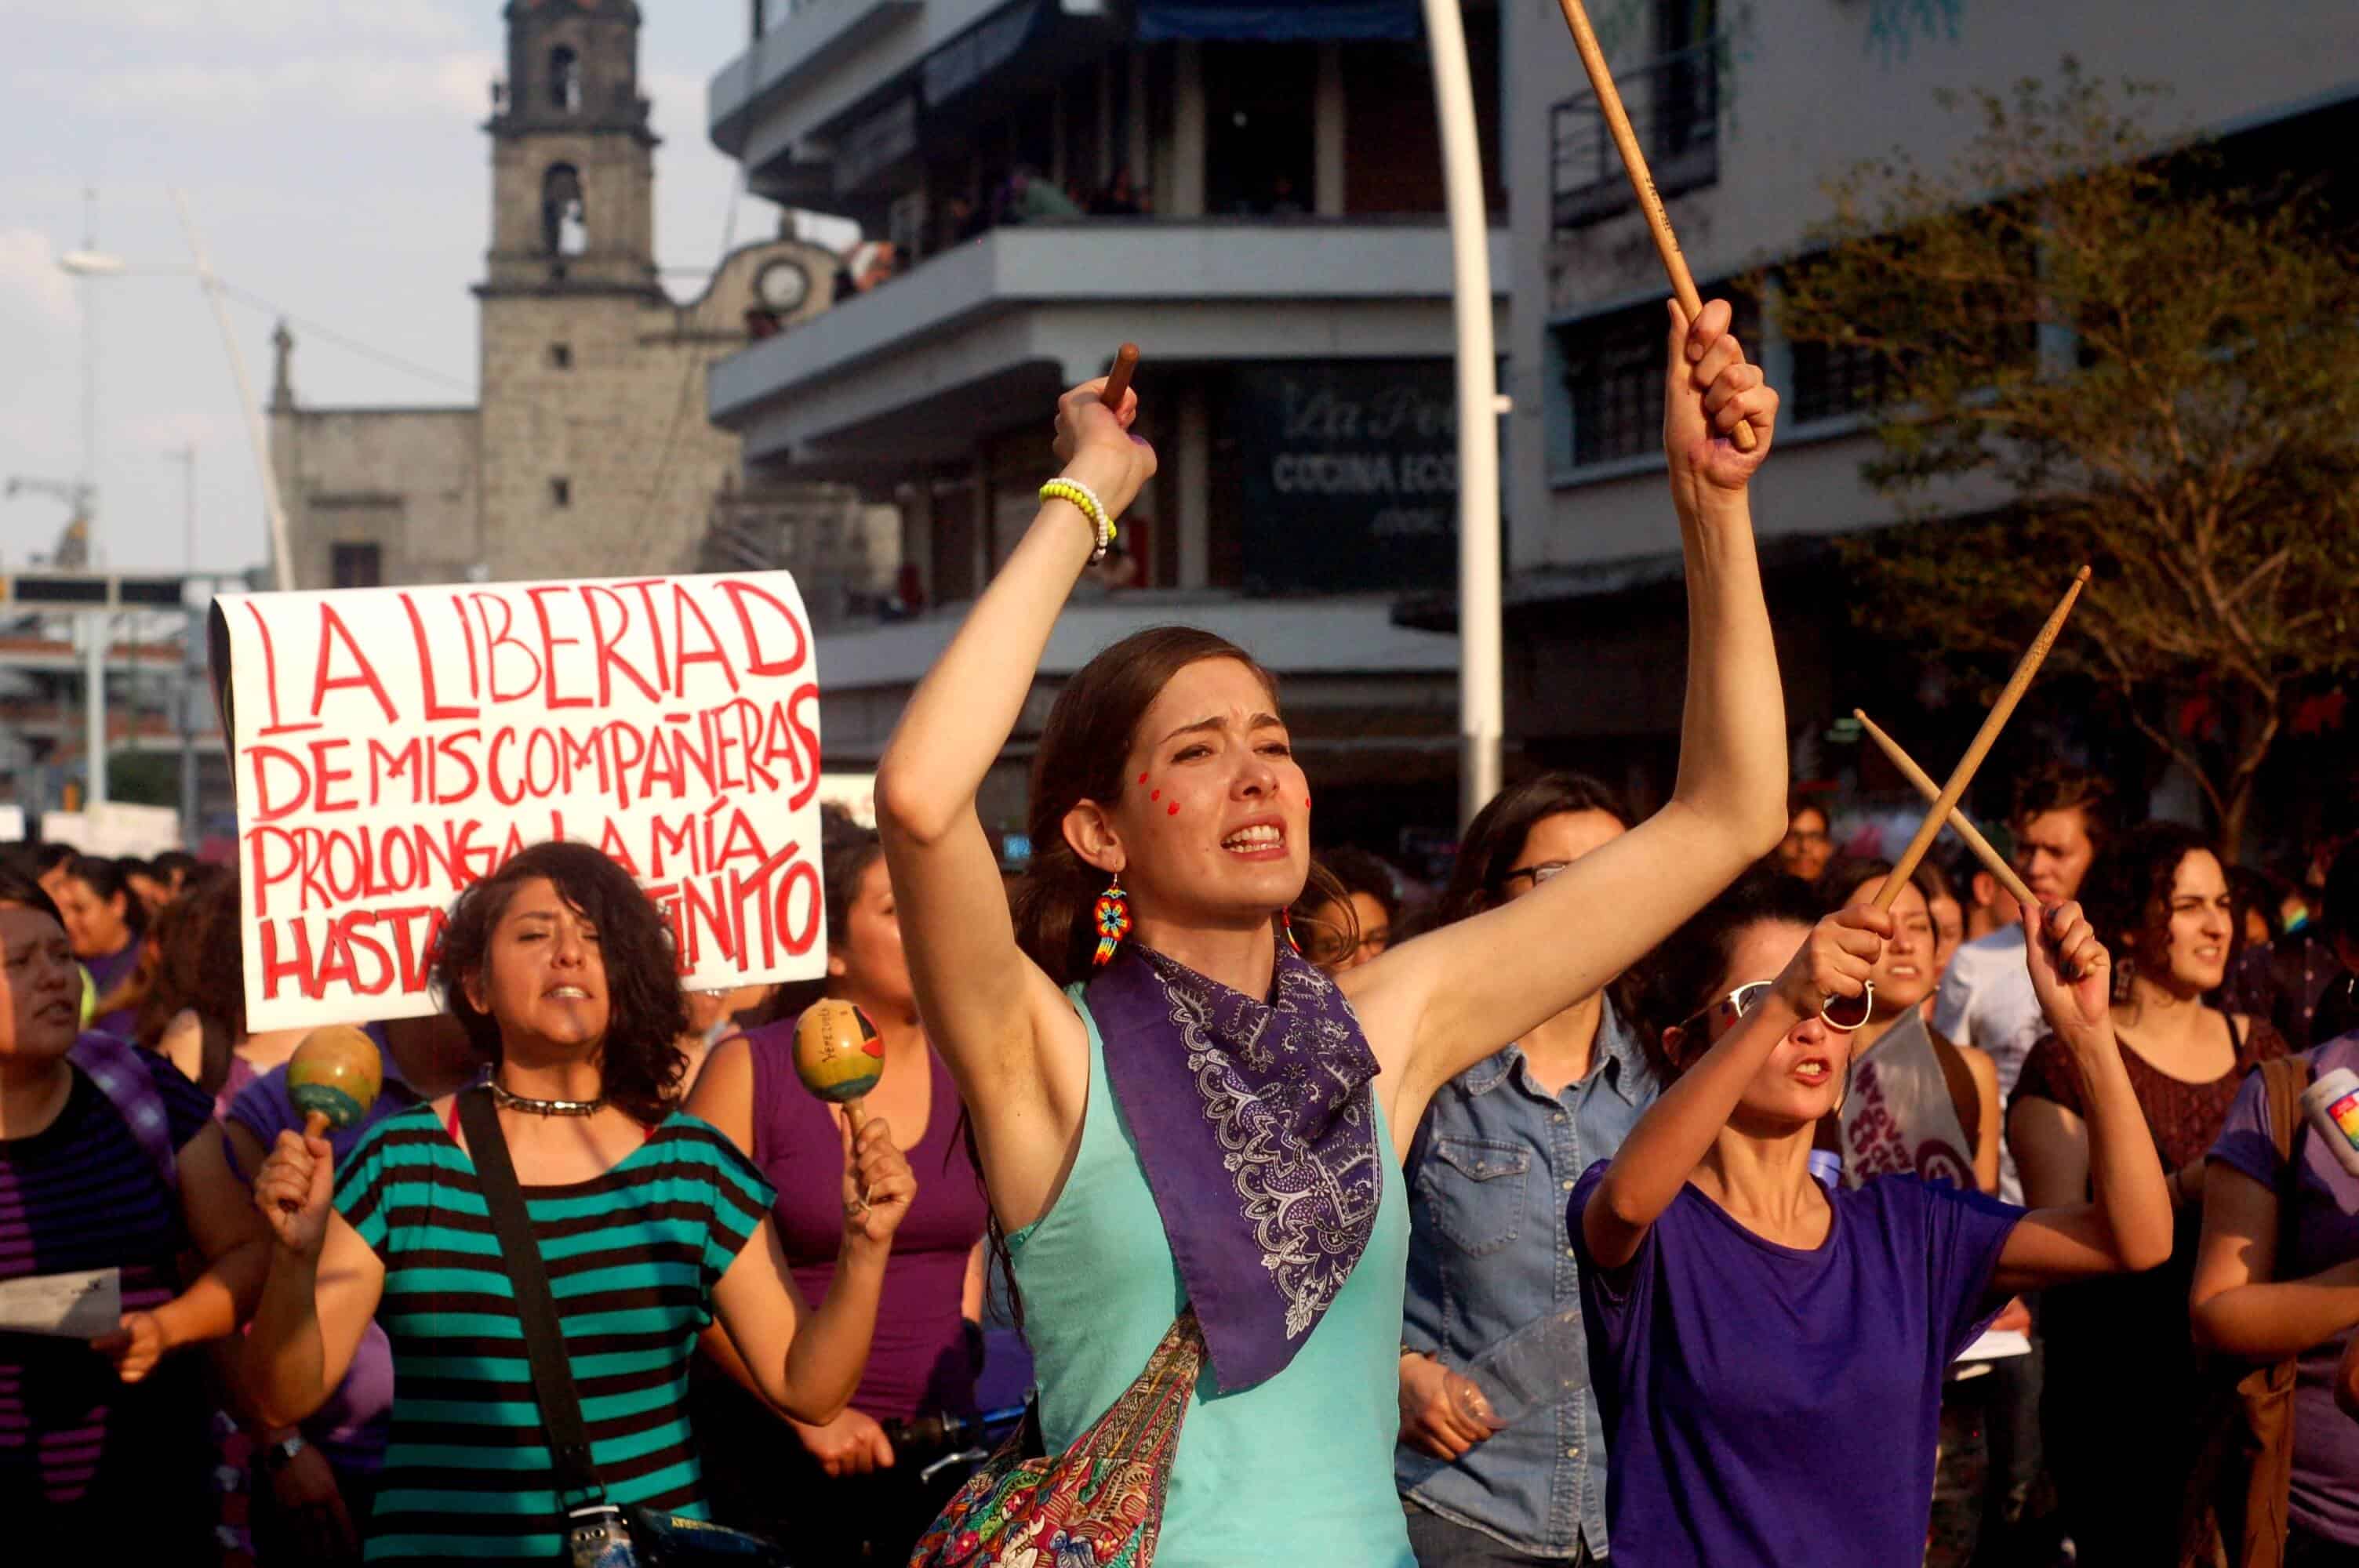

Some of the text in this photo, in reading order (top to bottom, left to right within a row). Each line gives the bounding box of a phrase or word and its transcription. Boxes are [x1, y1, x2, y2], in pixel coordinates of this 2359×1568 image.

[246, 579, 807, 737] LA LIBERTAD
[242, 682, 822, 823] DE MIS COMPAÑERAS
[651, 794, 770, 880] MÍA
